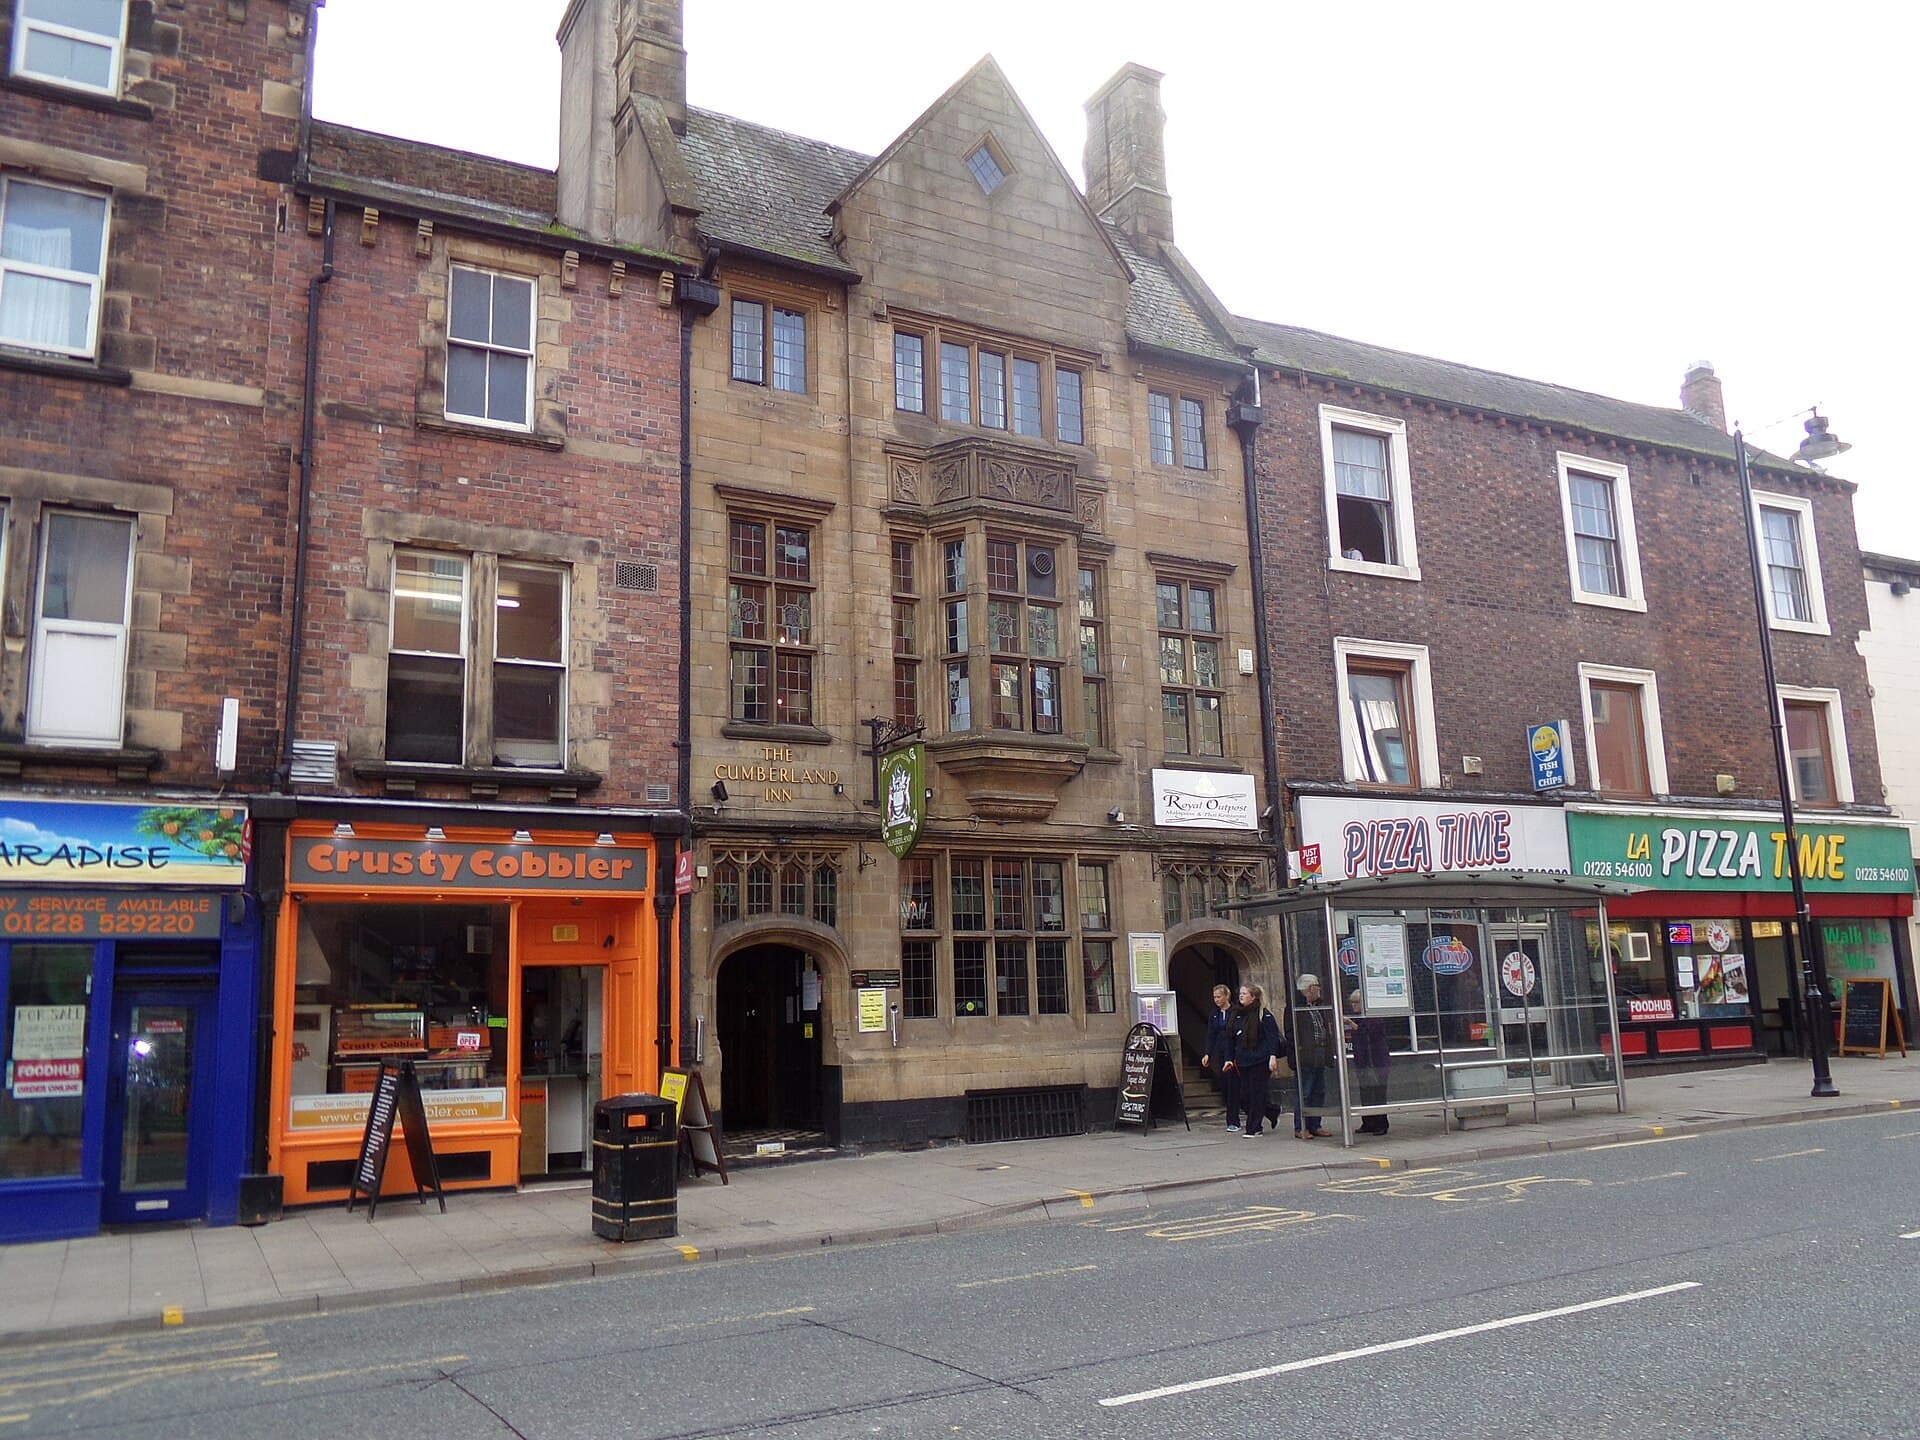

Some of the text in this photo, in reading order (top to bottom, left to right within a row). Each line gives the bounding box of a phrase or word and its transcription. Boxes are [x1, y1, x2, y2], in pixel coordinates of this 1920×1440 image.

[763, 747, 793, 762] THE
[1539, 760, 1558, 771] FISH
[715, 764, 840, 786] CUMBERLAND
[1538, 775, 1563, 787] CHIPS
[764, 788, 792, 802] INN
[1163, 795, 1248, 813] Royal Outpost
[1343, 810, 1511, 878] PIZZA TIME
[1302, 847, 1318, 859] JUST
[1627, 828, 1847, 880] LA PIZZA TME
[307, 844, 634, 881] Crusty Cobbler
[1306, 856, 1318, 866] EAT
[1583, 861, 1653, 877] 01228 546100
[1855, 867, 1910, 881] 01228 546100
[28, 898, 108, 912] SERVICE
[118, 898, 210, 913] AVAILABLE
[4, 913, 196, 933] 01228 529220
[1630, 999, 1673, 1012] FOODHUB
[341, 1040, 420, 1051] Crusty Cobbler
[459, 1037, 477, 1046] OPEN
[17, 1063, 80, 1078] FOODHUB
[17, 1085, 79, 1094] ORDER ONLINE
